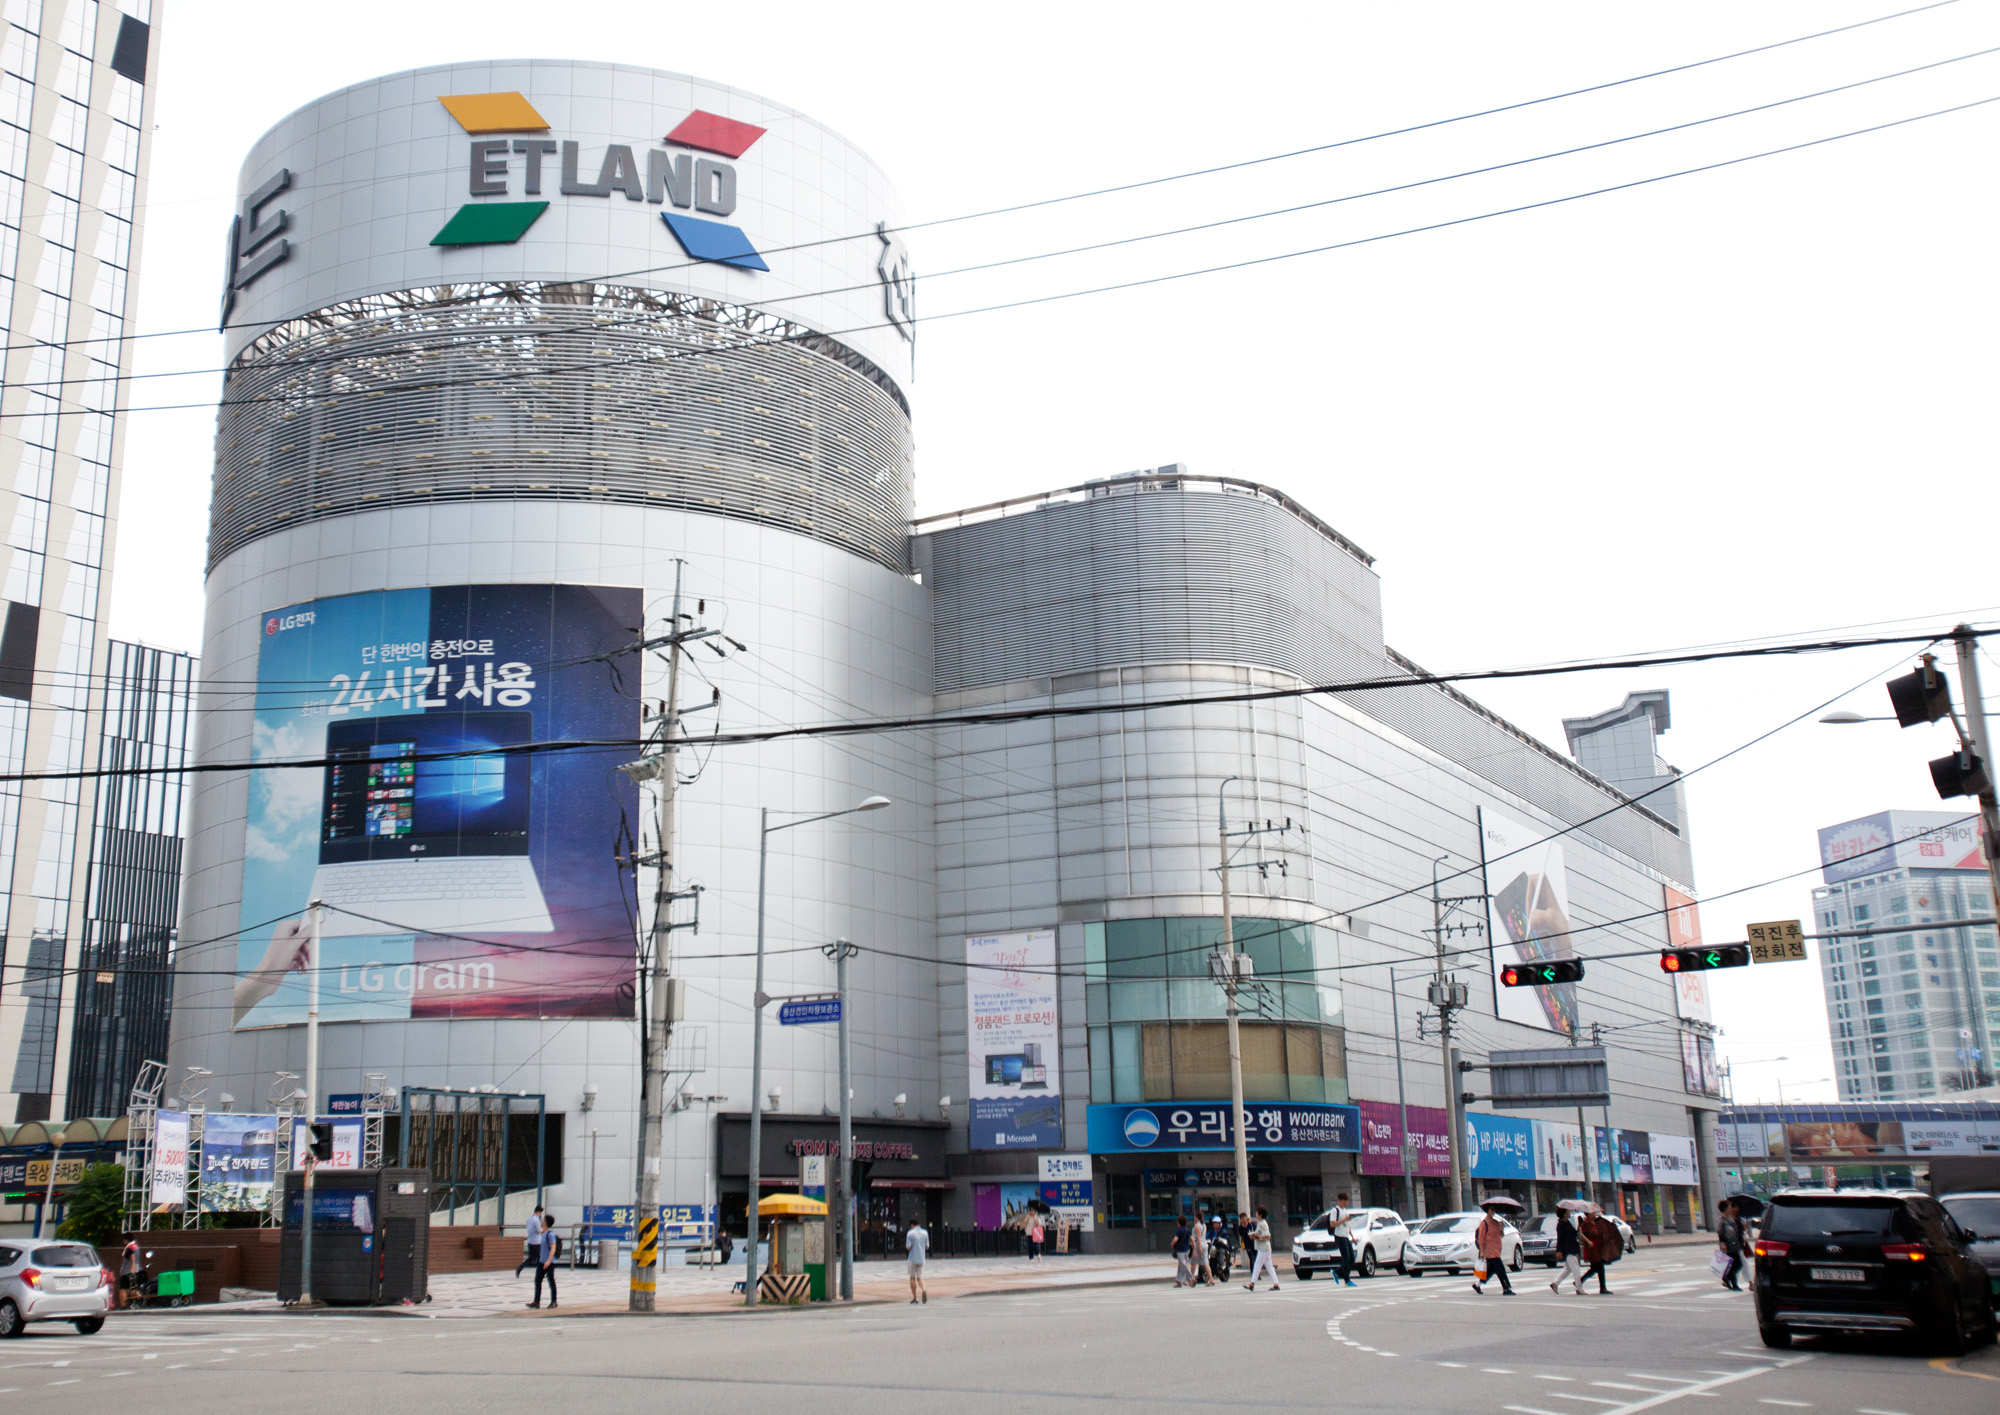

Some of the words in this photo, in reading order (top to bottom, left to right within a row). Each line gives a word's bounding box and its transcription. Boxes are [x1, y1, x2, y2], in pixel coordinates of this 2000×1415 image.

[470, 139, 737, 216] ETLAND
[279, 611, 316, 631] LG전자
[361, 646, 378, 664] 단
[380, 641, 426, 662] 한번의
[429, 639, 495, 660] 충전으로
[327, 664, 452, 715] 24시간
[455, 661, 536, 707] 사용
[1918, 826, 1972, 843] 모닝케어
[1751, 924, 1801, 941] 직진후
[1754, 942, 1804, 959] 좌회전
[339, 961, 384, 994] LG
[394, 962, 495, 1000] gram
[974, 1013, 1012, 1030] 정품랜드
[1013, 1011, 1055, 1026] 프로모션!
[1168, 1110, 1283, 1143] 우리은행
[1374, 1124, 1392, 1139] LG전자
[1006, 1133, 1037, 1143] Microsoft
[1290, 1128, 1340, 1143] 용산전자랜드지점
[1480, 1131, 1491, 1151] HP
[1492, 1131, 1513, 1155] 서비스
[1514, 1132, 1528, 1156] 센터
[1966, 1135, 1988, 1143] EOS
[793, 1139, 826, 1157] TOM
[874, 1142, 912, 1159] COFFEE
[231, 1157, 270, 1170] 전자랜드
[1062, 1160, 1083, 1171] 전자랜드
[0, 1165, 25, 1184] 랜드
[154, 1170, 184, 1188] 주차가능
[1203, 1170, 1237, 1184] 우리은
[1061, 1197, 1089, 1206] blu-ray
[662, 1208, 692, 1223] 입구
